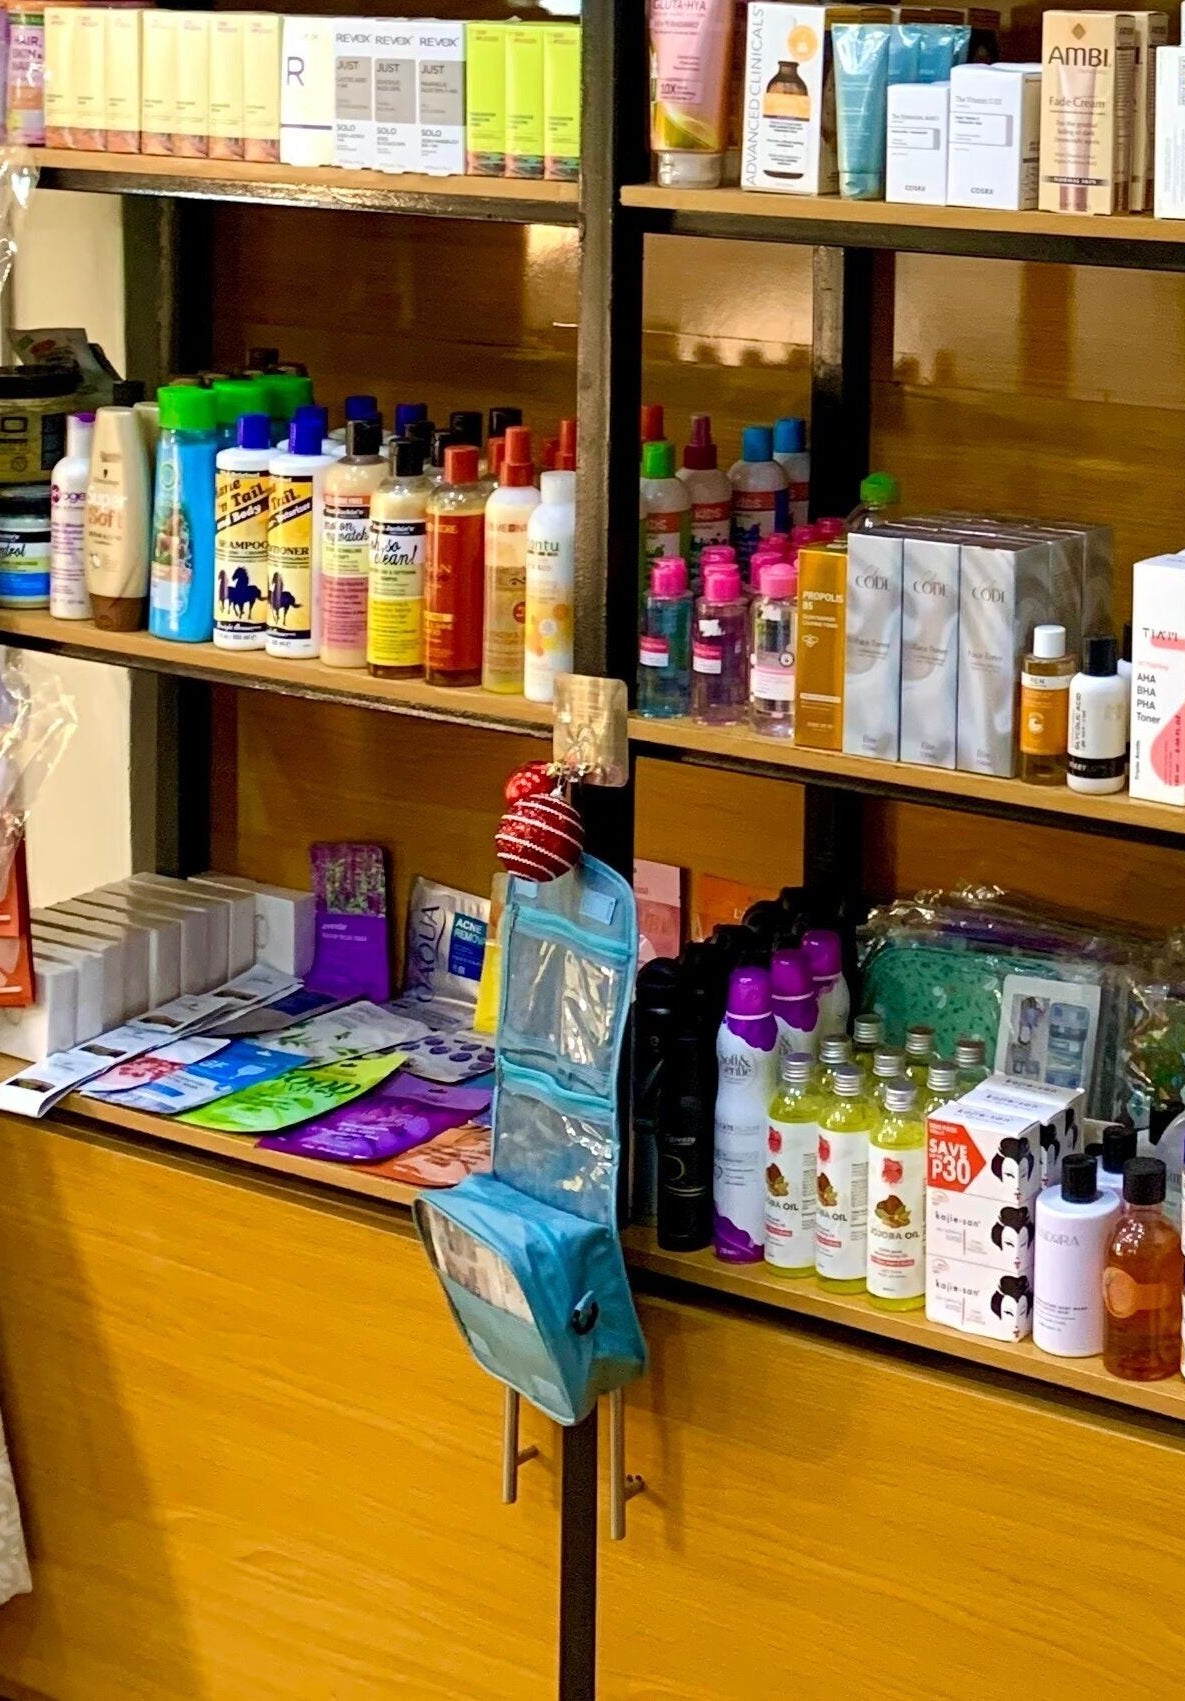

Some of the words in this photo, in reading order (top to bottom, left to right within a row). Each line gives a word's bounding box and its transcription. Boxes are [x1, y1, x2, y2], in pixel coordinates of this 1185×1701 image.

[336, 33, 372, 43] REVOX
[375, 35, 413, 45] REVOX
[419, 37, 459, 47] REVOX
[750, 8, 764, 96] CLINICALS
[1048, 46, 1109, 67] AMBI
[286, 56, 305, 86] R
[337, 61, 358, 70] JUST
[377, 63, 400, 72] JUST
[421, 65, 444, 74] JUST
[1049, 96, 1071, 107] Fade
[1073, 97, 1105, 108] Cream
[377, 127, 397, 135] SOLO
[421, 129, 442, 137] SOLO
[745, 100, 761, 185] ADVANCED
[803, 591, 844, 603] PROPOLIS
[1137, 672, 1156, 683] AHA
[1137, 685, 1156, 697] BHA
[1136, 699, 1156, 710] PHA
[1136, 712, 1160, 724] Toner
[455, 917, 483, 934] ACNE
[929, 1138, 968, 1159] SAVE
[782, 1203, 799, 1211] OIL
[832, 1213, 848, 1222] OIL
[904, 1230, 920, 1239] OIL
